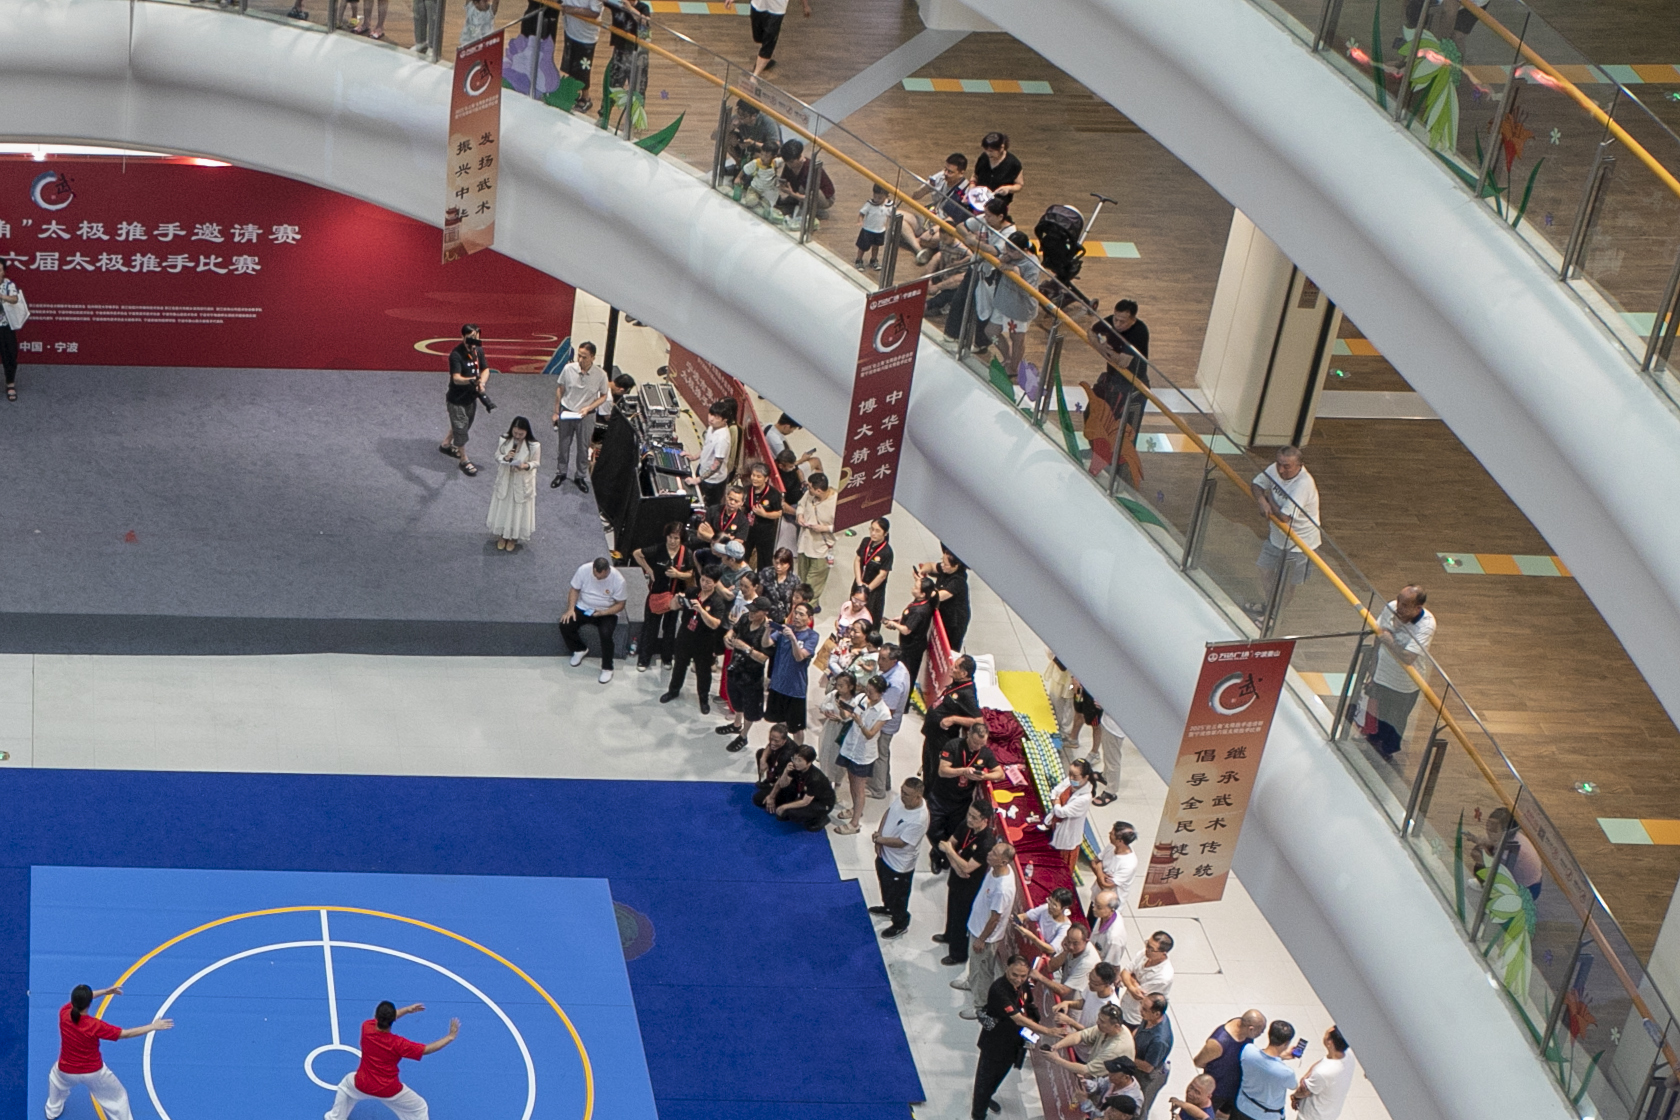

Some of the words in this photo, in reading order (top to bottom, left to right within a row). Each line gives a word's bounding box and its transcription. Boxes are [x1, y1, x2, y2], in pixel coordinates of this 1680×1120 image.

[455, 139, 473, 218] 振兴中华
[475, 131, 495, 215] 发扬武术
[847, 397, 877, 488] 博大精深
[873, 390, 903, 480] 中华武术
[1161, 748, 1216, 881] 倡导全民健身
[1192, 746, 1247, 878] 继承武术传统
